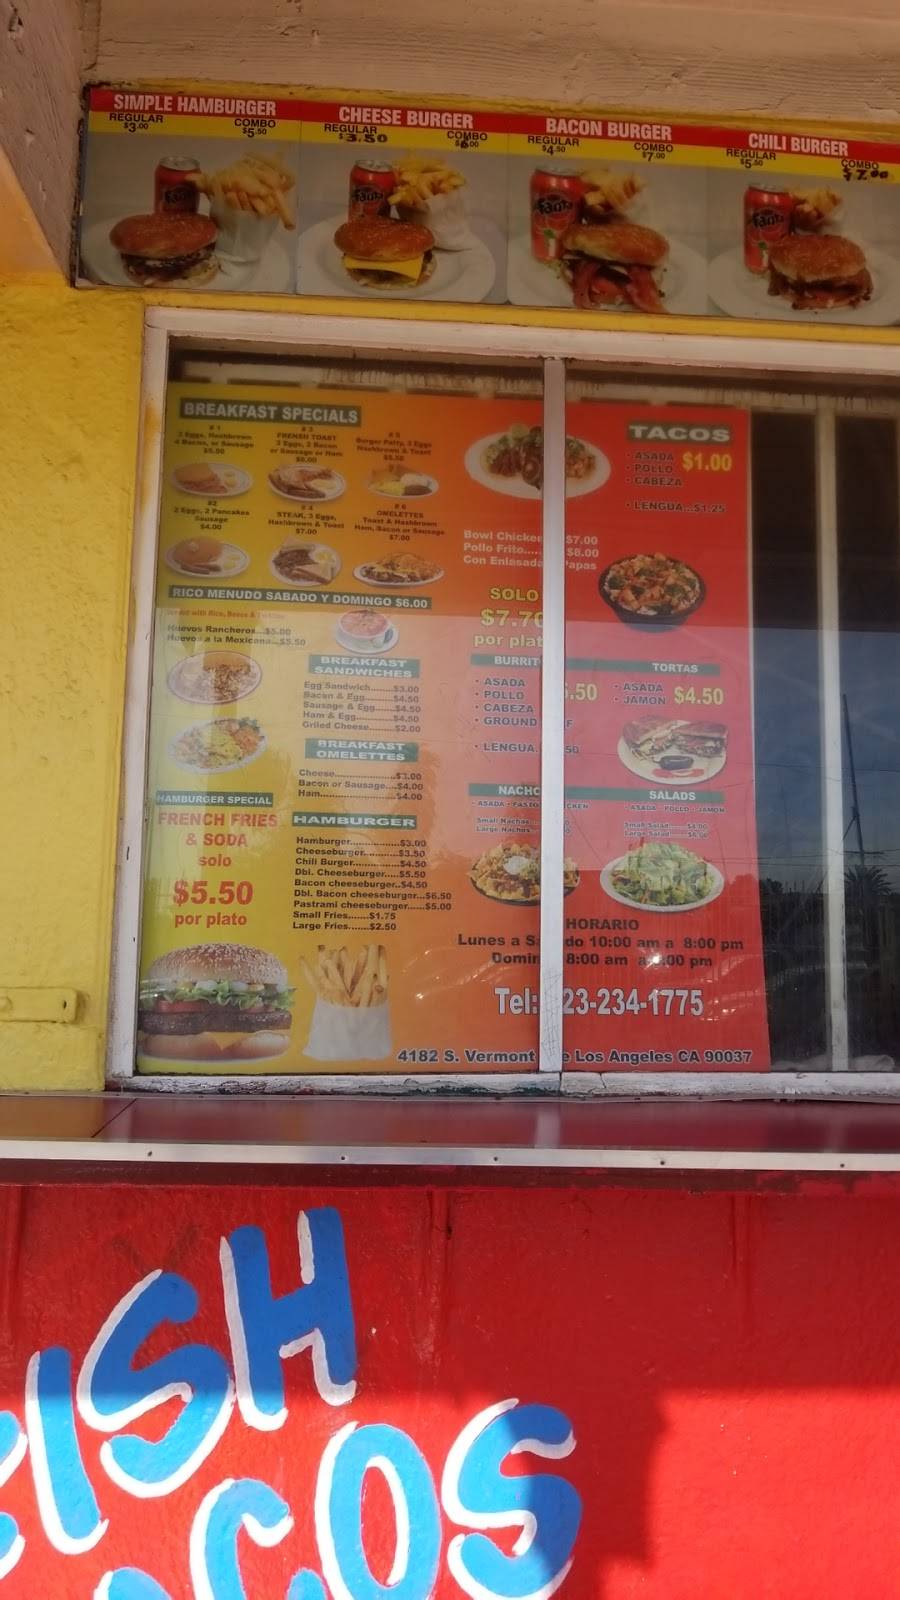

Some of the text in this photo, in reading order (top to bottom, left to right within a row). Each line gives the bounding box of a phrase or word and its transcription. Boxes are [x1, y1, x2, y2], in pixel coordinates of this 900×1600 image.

[114, 94, 276, 116] SIMPLE HAMBURGER
[109, 113, 164, 123] REGULAR
[234, 118, 276, 128] COMBO
[339, 106, 474, 129] CHEESE BURGER
[324, 124, 377, 134] REGULAR
[546, 117, 672, 140] BACON BURGER
[447, 131, 488, 141] COMBO
[528, 135, 579, 146] REGULAR
[634, 142, 674, 153] COMBO
[748, 133, 849, 156] CHILI BURGER
[726, 149, 777, 160] REGULAR
[841, 159, 880, 170] COMBO
[184, 402, 359, 424] BREAKFAST SPECIALS
[629, 425, 730, 442] TACOS
[635, 452, 673, 461] ASADA
[682, 451, 732, 472] $1.00
[634, 464, 673, 473] POLLO
[635, 476, 682, 486] CABEZA
[464, 529, 598, 545] Bowl $7.00
[464, 542, 599, 558] Pollo $8.00
[464, 555, 486, 565] Con
[172, 587, 428, 608] RICO MENUDO SABADO Y DOMINGO $6.00
[490, 587, 539, 601] SOLO
[474, 634, 543, 648] por plat
[320, 656, 407, 667] BREAKFAST
[494, 656, 540, 666] BURRIT
[314, 666, 412, 678] SANDWICHES
[652, 662, 698, 673] TORTAS
[304, 681, 321, 690] Egg
[484, 677, 525, 687] ASADA
[623, 683, 663, 692] ASADA
[303, 691, 333, 700] Bacon
[336, 692, 344, 700] &
[484, 690, 525, 700] POLLO
[623, 695, 666, 705] JAMON
[674, 686, 724, 705] $4.50
[303, 702, 343, 711] Sausage
[484, 703, 534, 713] CABEZA
[303, 711, 324, 719] Ham
[483, 716, 537, 726] GROUND
[318, 740, 405, 750] BREAKFAST
[316, 751, 406, 761] OMELETTES
[298, 779, 329, 788] Bacon
[159, 794, 272, 805] HAMBURGER SPECIAL
[649, 790, 696, 800] SALADS
[158, 812, 278, 827] FRENCH FRIES
[293, 815, 416, 827] HAMBURGER
[186, 833, 248, 846] & SODA
[199, 854, 232, 867] solo
[296, 858, 317, 866] Chili
[294, 879, 326, 887] Bacon
[173, 880, 254, 906] $5.50
[316, 890, 347, 898] Bacon
[293, 900, 338, 908] Pastrami
[175, 912, 247, 928] por plato
[292, 911, 321, 919] Small
[292, 922, 321, 931] Large
[566, 918, 639, 930] HORARIO
[458, 934, 744, 952] Lunes a 10:00 am a 8:00 pm
[566, 953, 713, 968] 8:00 am pm
[494, 987, 704, 1016] Tel: 23-234-1775
[397, 1050, 752, 1065] 4182 S. Vermont Los Angeles CA 90037
[0, 1207, 358, 1582] ISH
